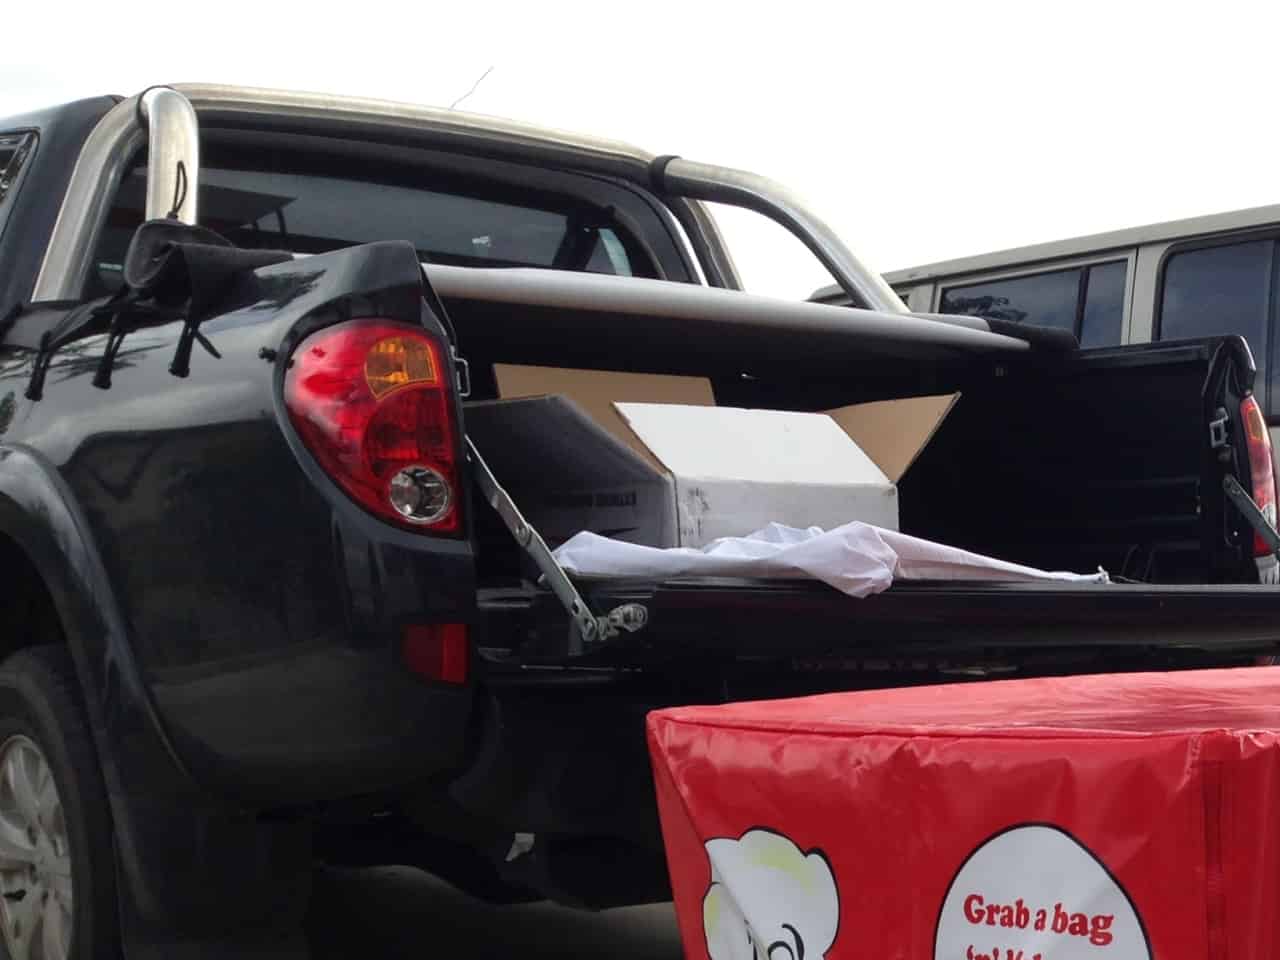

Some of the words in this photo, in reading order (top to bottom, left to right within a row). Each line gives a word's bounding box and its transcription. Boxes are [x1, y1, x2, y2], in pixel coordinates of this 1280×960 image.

[963, 894, 1030, 931] Grab
[1034, 906, 1048, 933] a
[1053, 903, 1115, 946] bag
